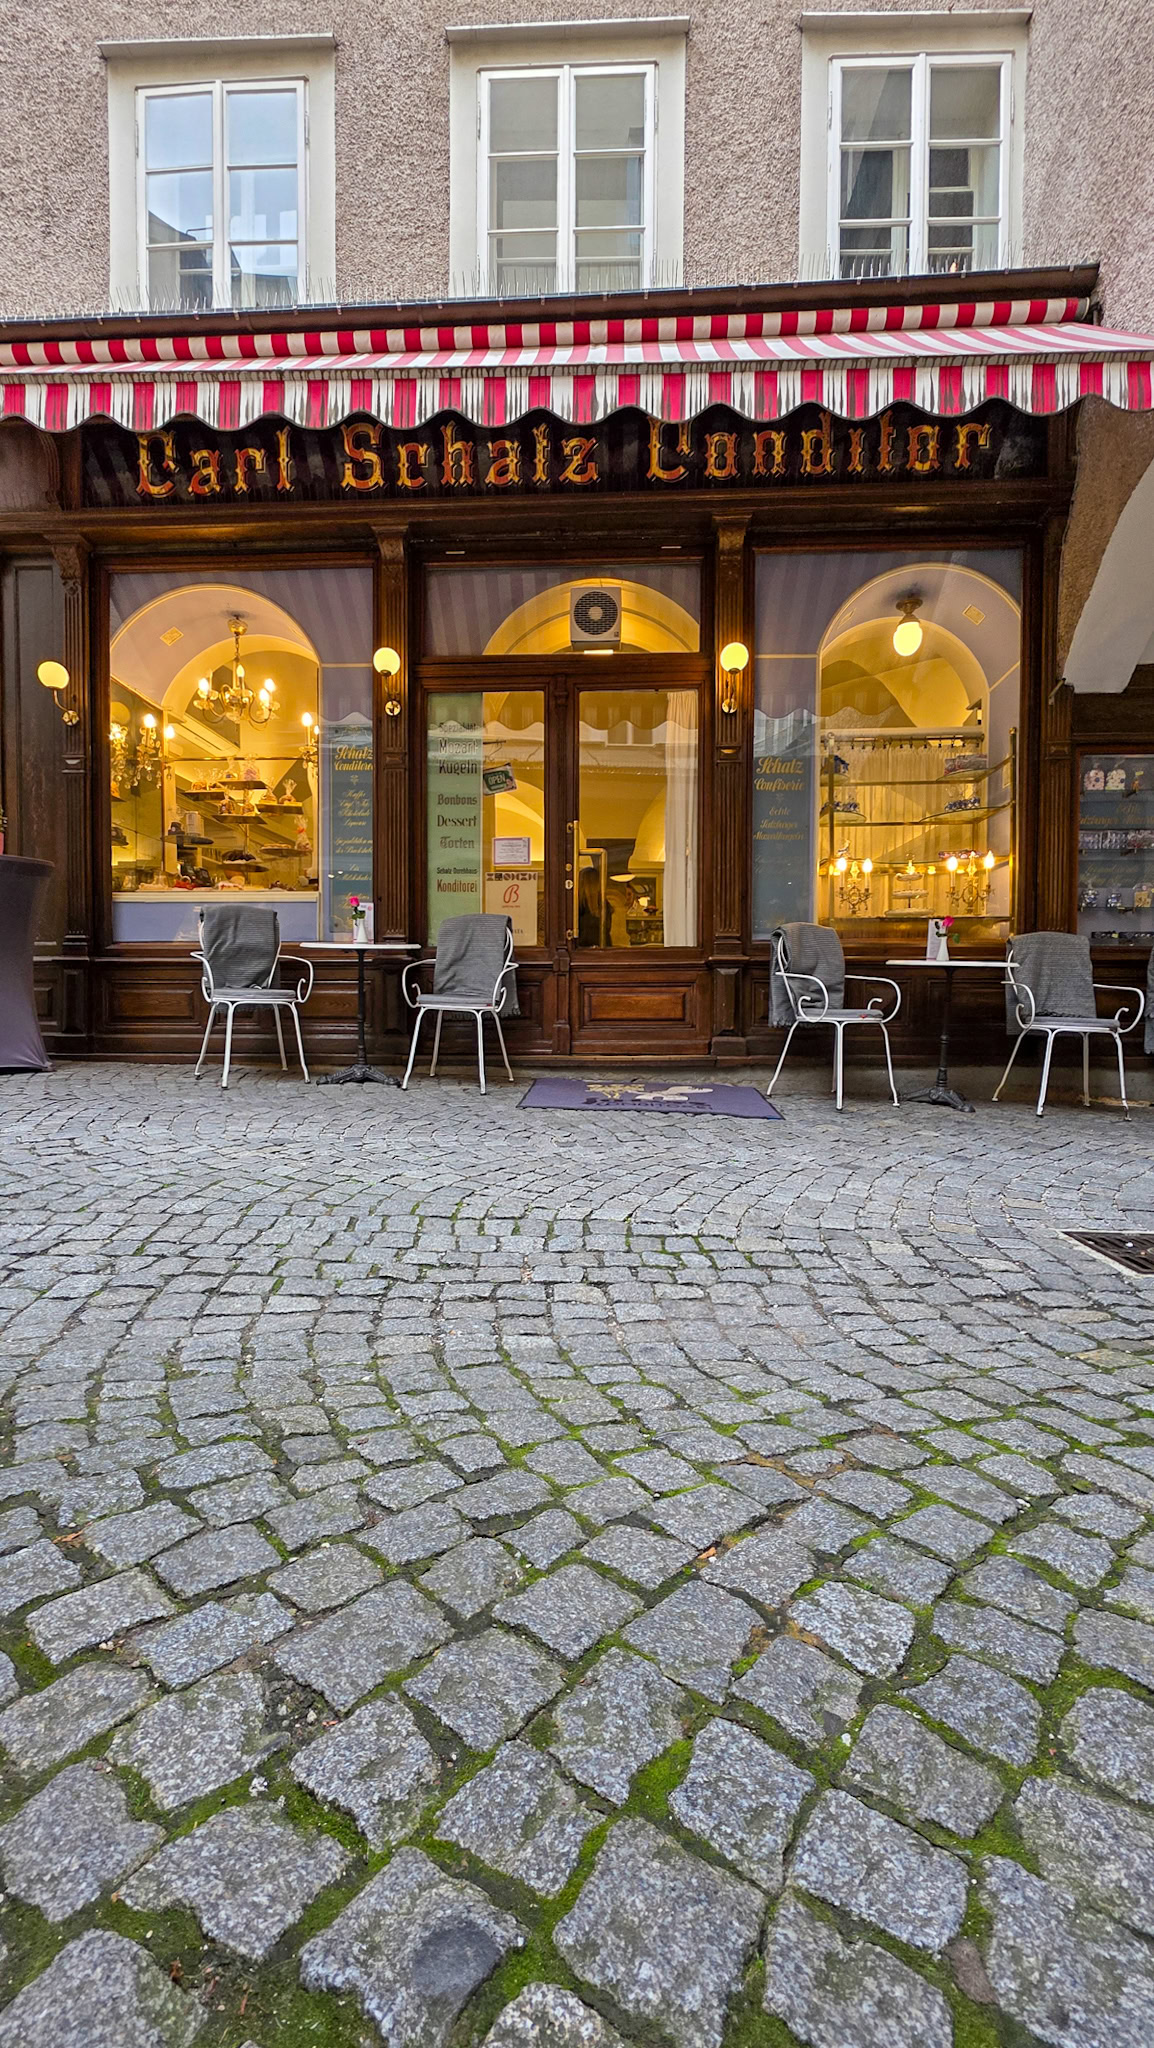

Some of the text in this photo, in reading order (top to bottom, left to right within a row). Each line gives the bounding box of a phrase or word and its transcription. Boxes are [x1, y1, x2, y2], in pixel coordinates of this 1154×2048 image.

[136, 409, 992, 496] Carl Schatz Conditor
[335, 744, 374, 760] Schatz
[438, 759, 478, 776] Kugeln
[756, 756, 804, 774] Schatz
[488, 773, 506, 785] OPEN
[754, 778, 805, 792] Confiserie
[437, 793, 478, 805] Bonbons
[437, 814, 478, 827] Dessert
[440, 836, 475, 849] Torten
[437, 879, 478, 893] Konditorei
